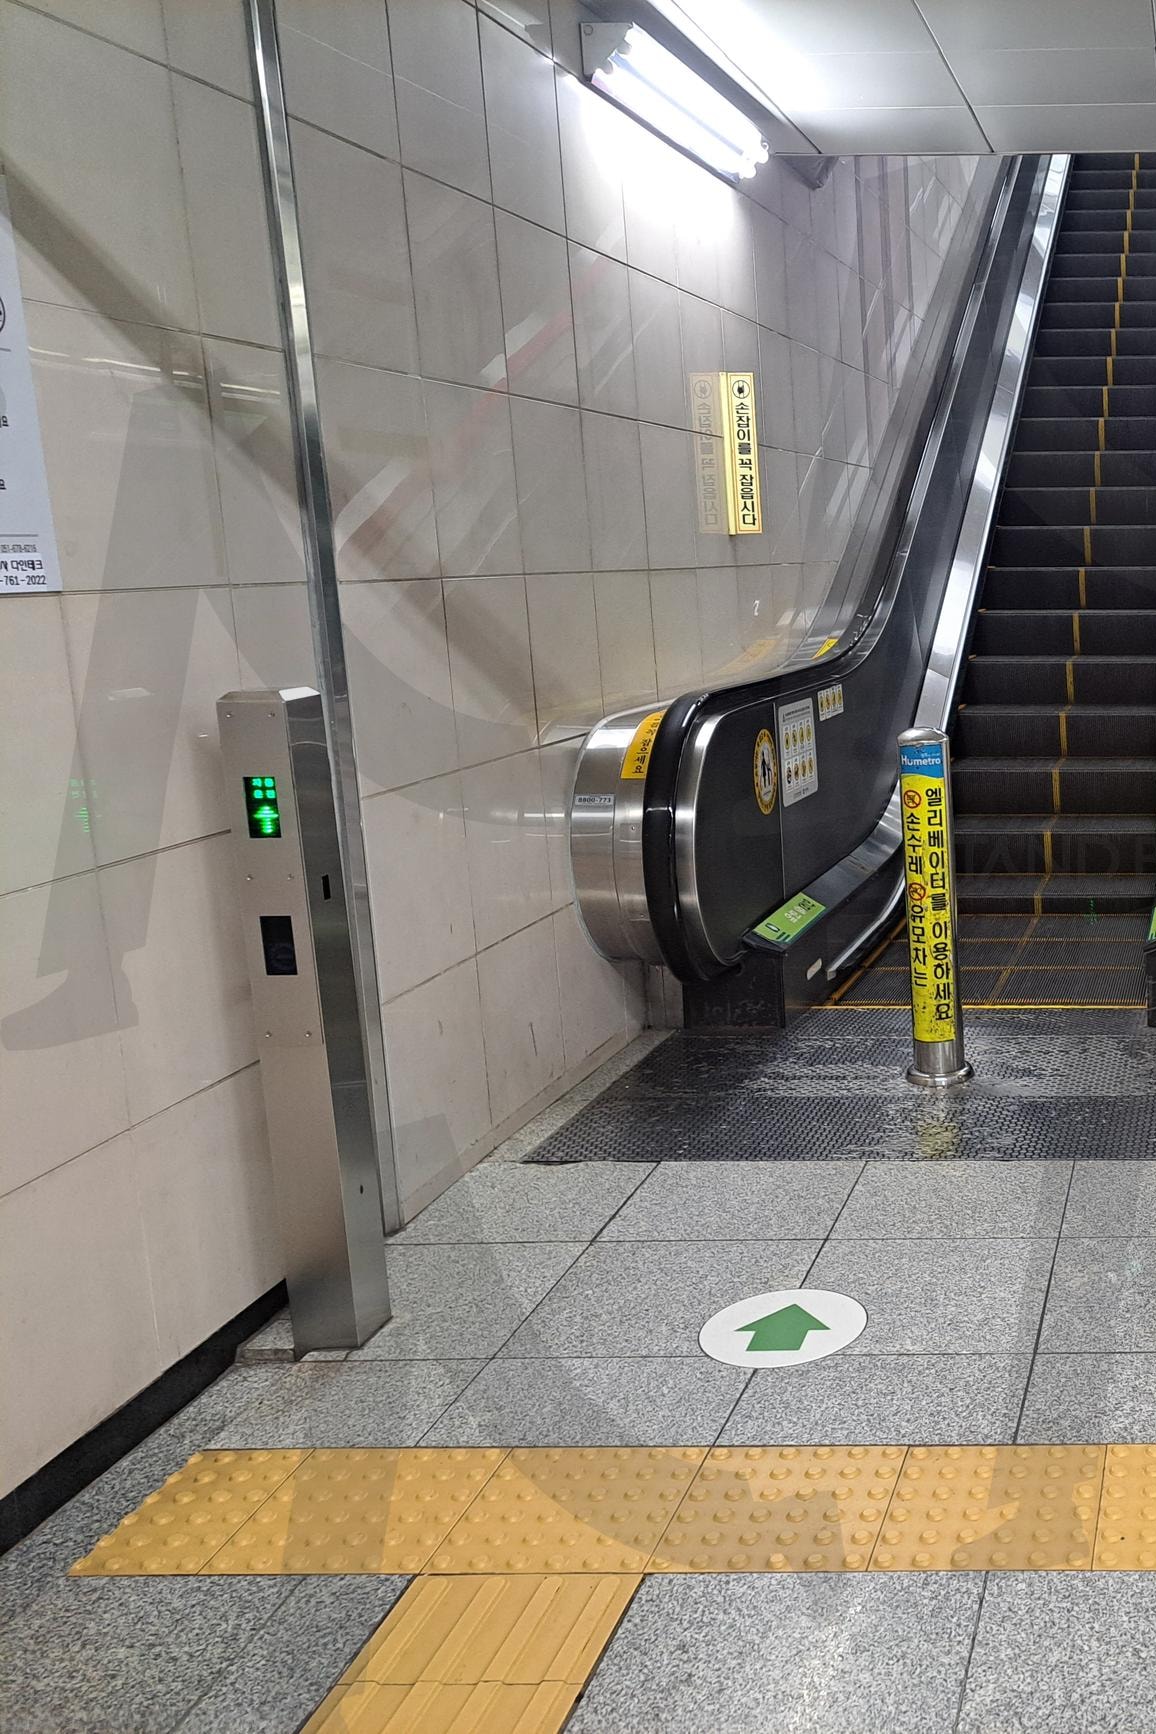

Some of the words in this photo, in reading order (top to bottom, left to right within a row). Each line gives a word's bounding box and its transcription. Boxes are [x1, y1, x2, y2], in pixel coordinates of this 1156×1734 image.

[735, 401, 752, 455] 손잡이를
[738, 458, 752, 471] 꼭
[739, 474, 757, 526] 잡읍시다
[901, 755, 941, 766] Humetro
[906, 812, 922, 875] 손수레
[925, 787, 947, 912] 엘리베이터를
[911, 904, 928, 988] 유모차는
[932, 921, 953, 1021] 이용하세요
